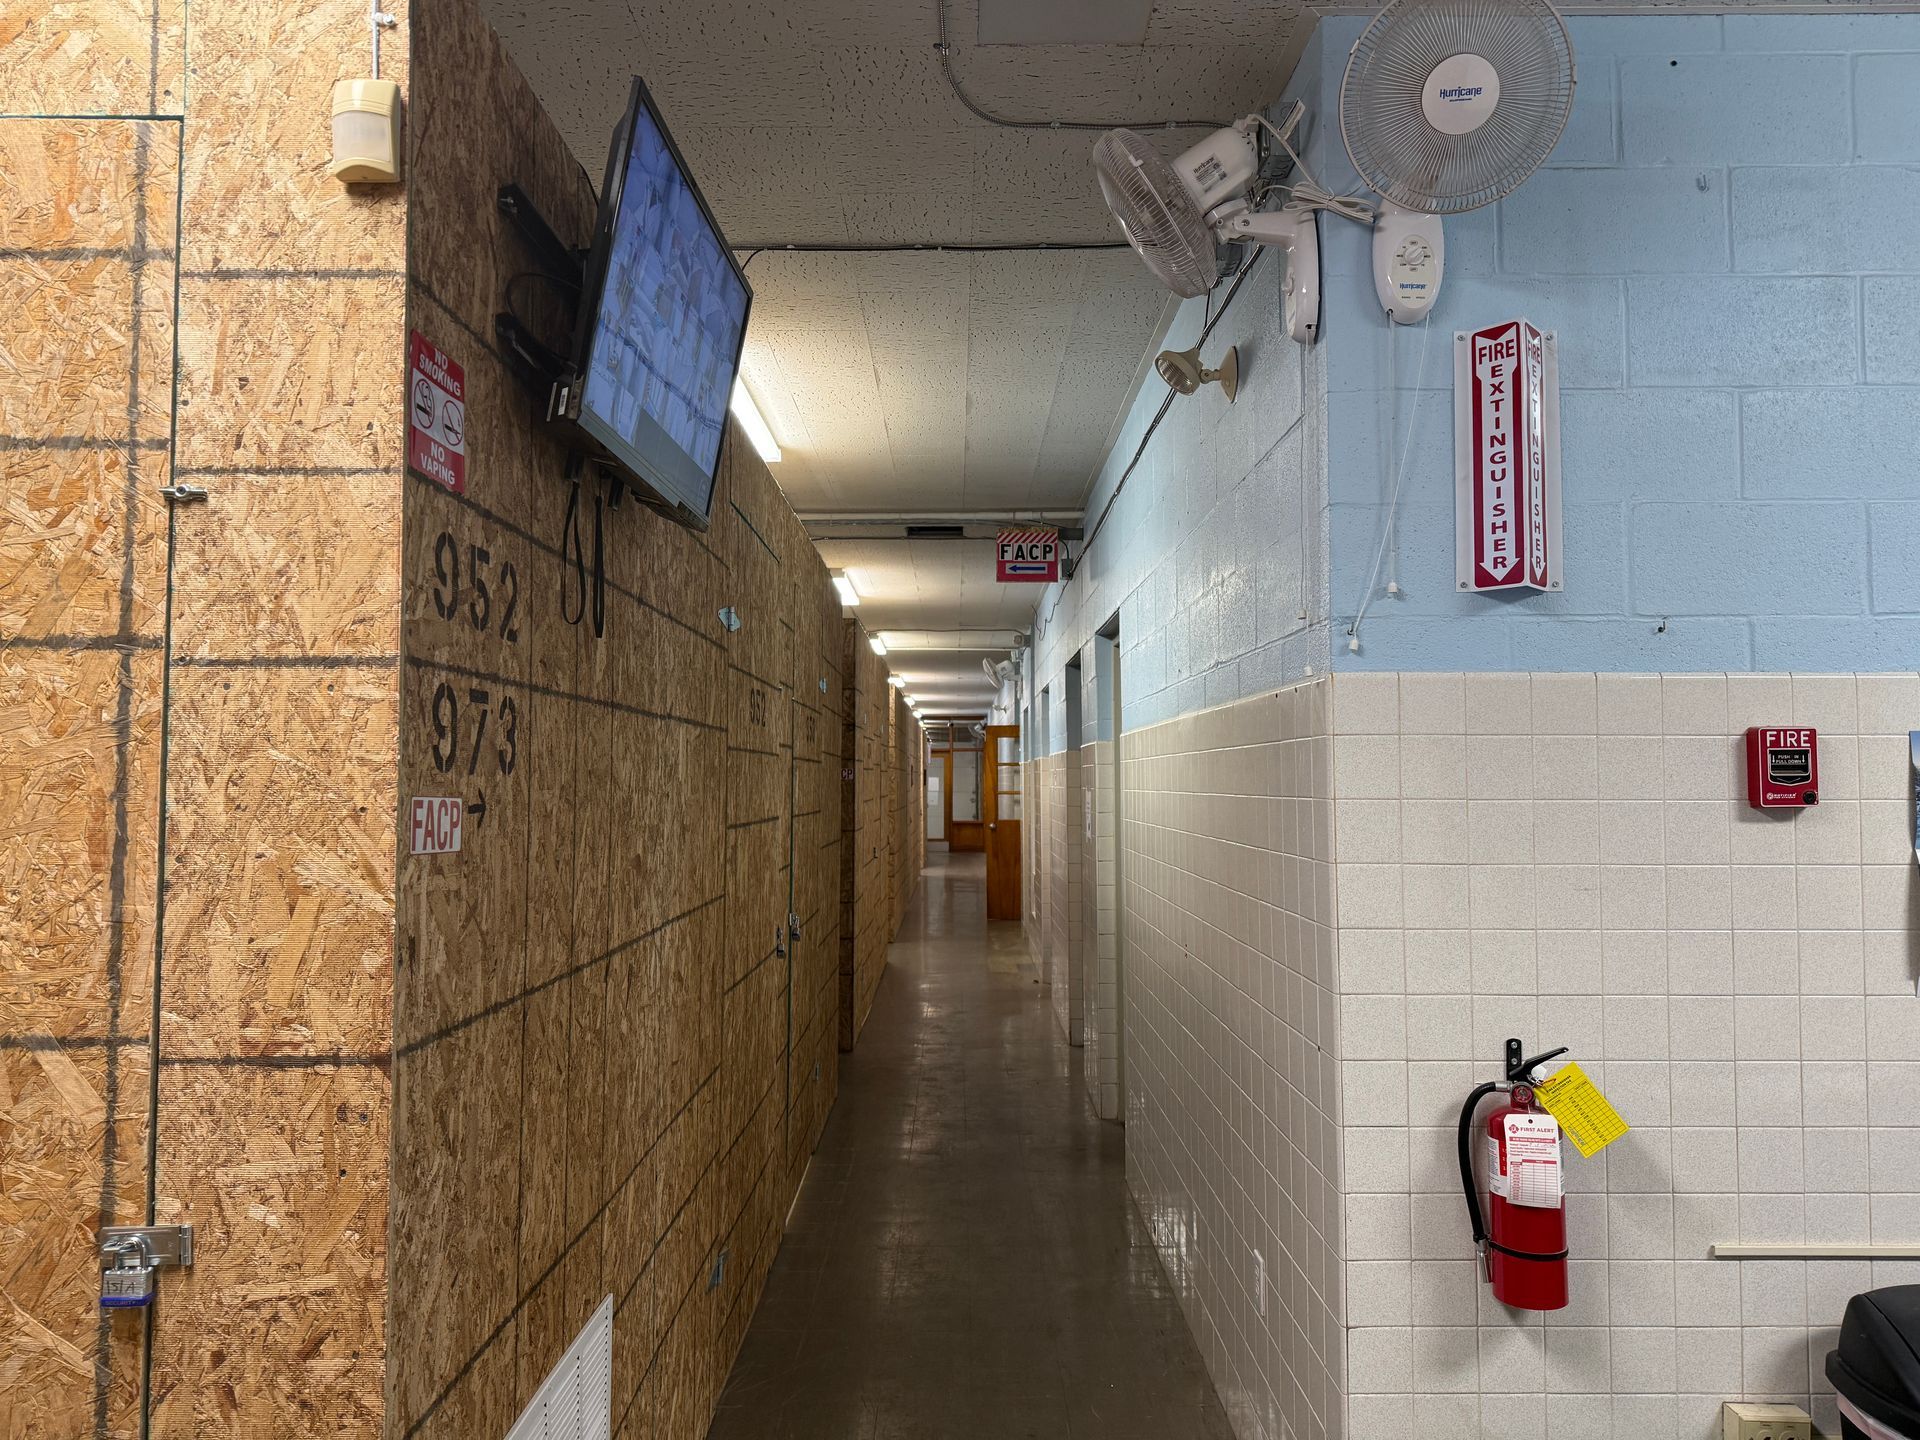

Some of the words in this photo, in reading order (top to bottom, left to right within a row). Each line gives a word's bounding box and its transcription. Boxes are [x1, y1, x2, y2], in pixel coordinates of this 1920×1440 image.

[1440, 86, 1482, 99] Hurricane
[434, 348, 448, 370] NO
[1479, 338, 1516, 366] FIRE
[1527, 338, 1541, 365] FIRE
[419, 354, 461, 397] SMOKING
[431, 441, 445, 462] NO
[1489, 363, 1508, 570] EXTINGUISHER
[1530, 364, 1542, 570] EXTINGUISHER
[421, 453, 456, 485] VAPING
[1000, 543, 1053, 560] FACP
[433, 531, 518, 643] 952
[750, 688, 766, 727] 952
[432, 682, 517, 776] 973
[1766, 731, 1811, 747] FIRE
[411, 799, 461, 852] FACP
